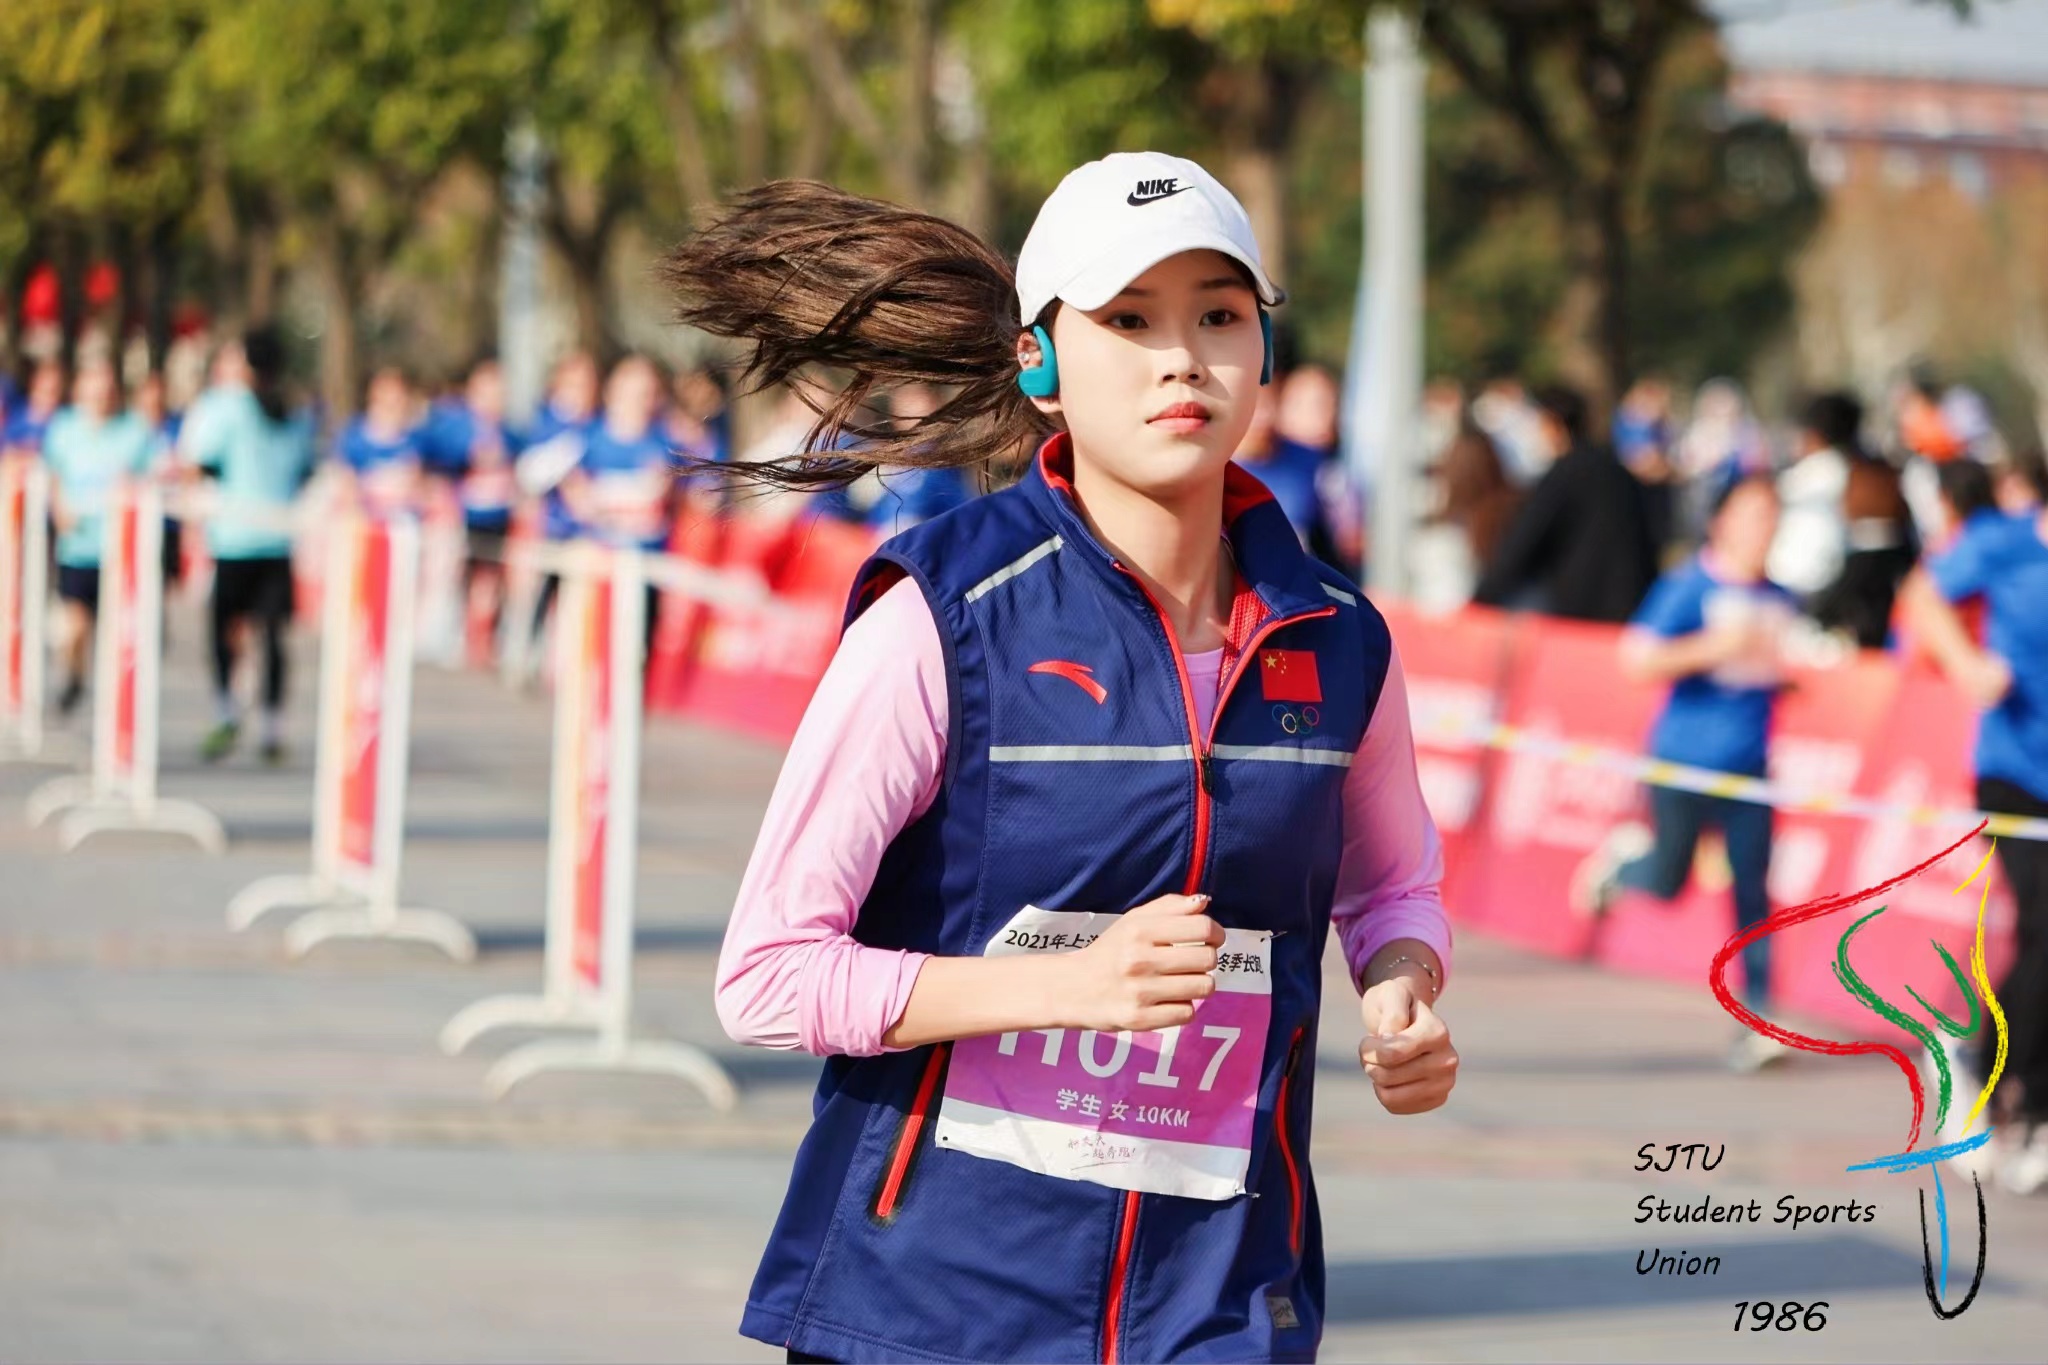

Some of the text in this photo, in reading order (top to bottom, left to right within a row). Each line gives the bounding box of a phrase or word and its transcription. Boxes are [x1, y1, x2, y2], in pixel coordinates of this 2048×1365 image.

[1136, 178, 1178, 196] NIKE
[1055, 1087, 1191, 1128] 学生 女 10KM
